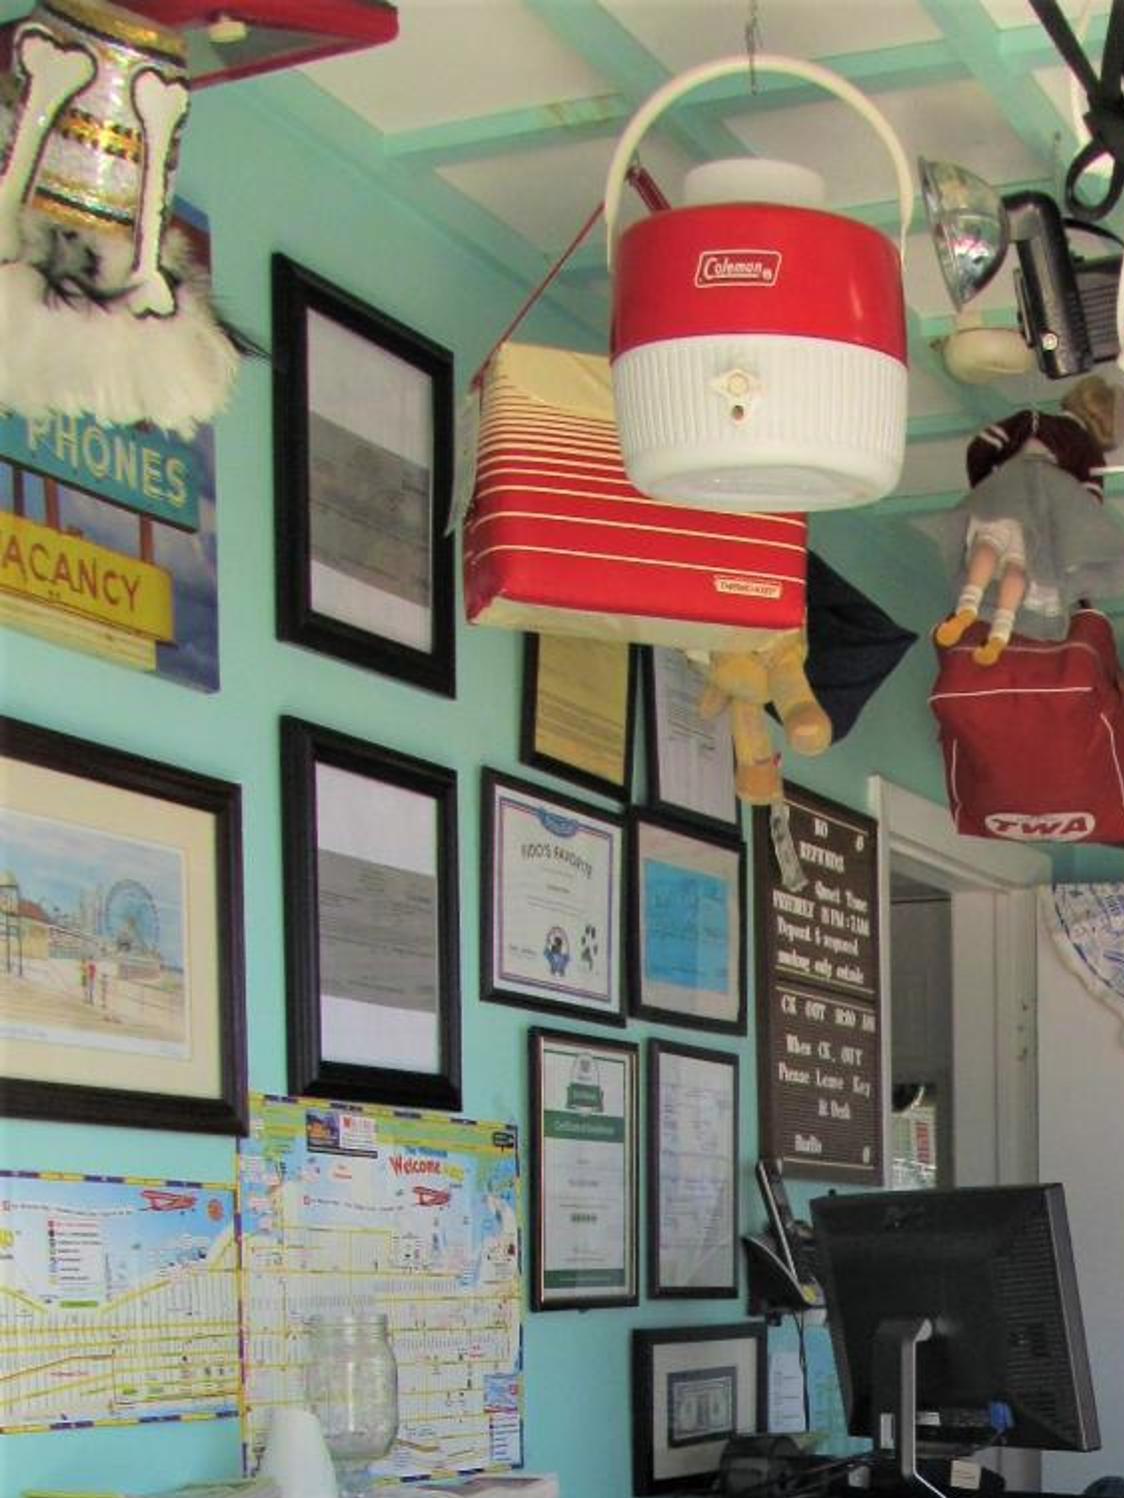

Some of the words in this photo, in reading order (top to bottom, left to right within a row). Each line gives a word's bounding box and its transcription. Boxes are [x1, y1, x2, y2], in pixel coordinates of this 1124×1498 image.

[703, 256, 763, 279] Coleman
[28, 414, 188, 508] PHONES
[0, 532, 140, 612] ACANCY
[990, 815, 1088, 834] TWA
[389, 1156, 441, 1175] Welcome
